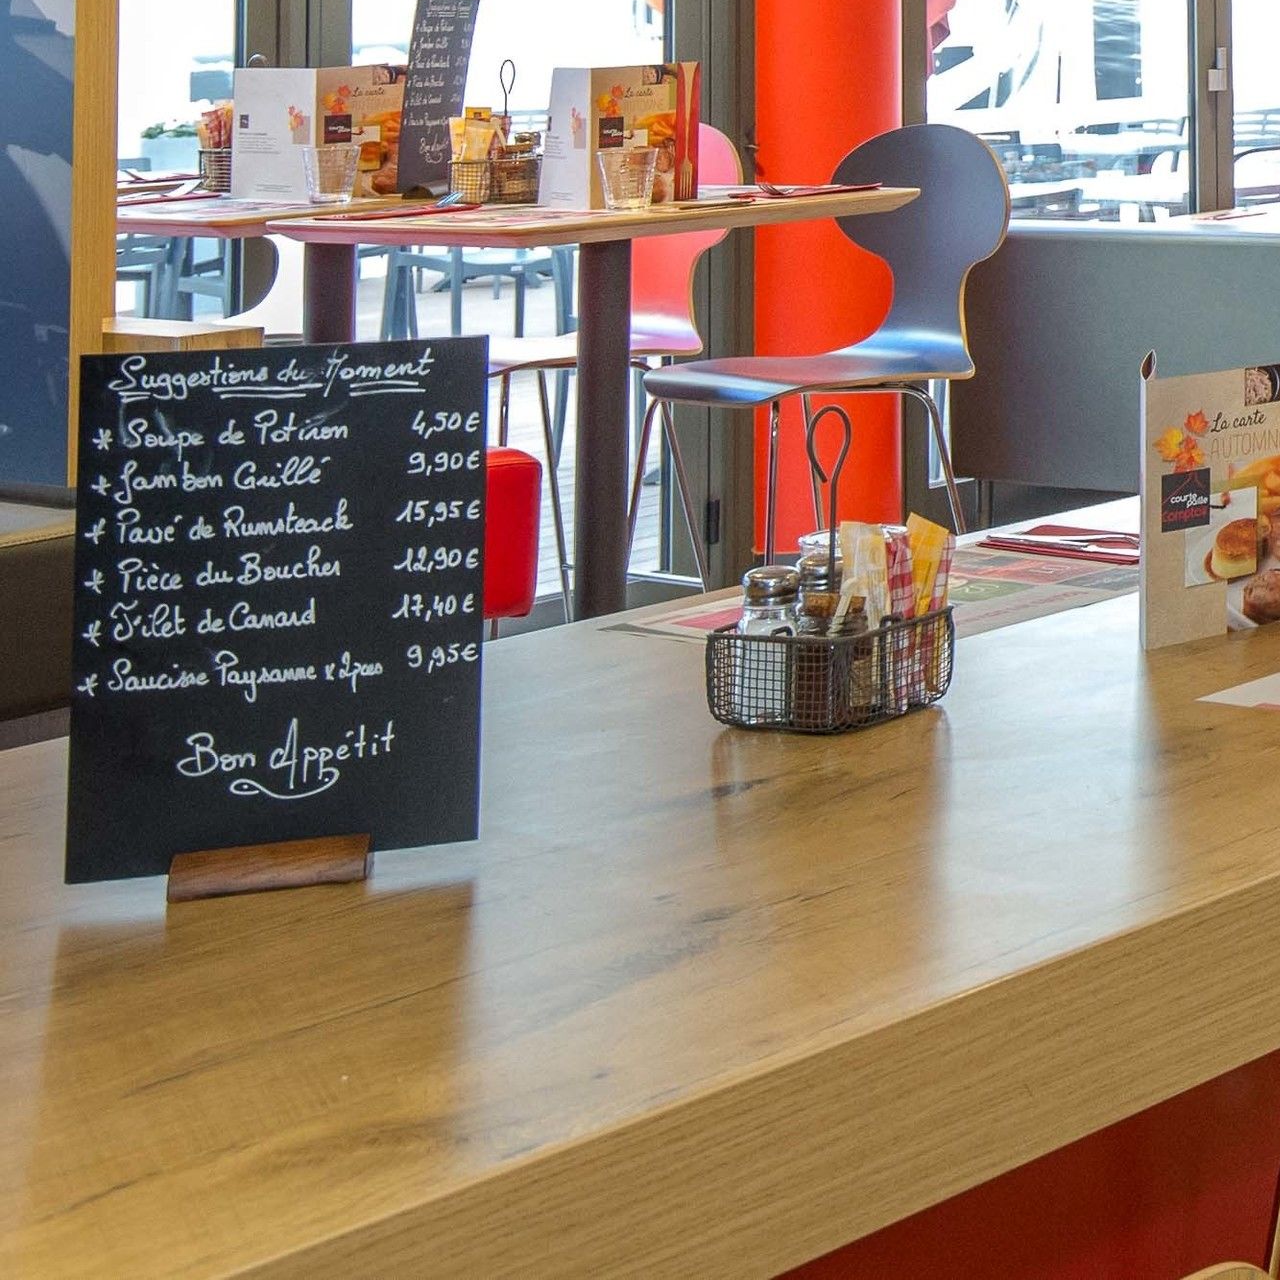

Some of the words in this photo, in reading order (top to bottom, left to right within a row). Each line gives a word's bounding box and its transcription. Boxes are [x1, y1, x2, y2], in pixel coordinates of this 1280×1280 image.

[108, 355, 269, 400] Suggestions
[276, 357, 308, 382] du
[125, 420, 205, 462] Soupe
[219, 419, 246, 446] de
[254, 409, 349, 443] Potiron
[410, 409, 481, 440] 4,50€
[1210, 411, 1231, 433] La
[1232, 409, 1267, 427] carte
[113, 462, 224, 504] Jambon
[233, 456, 332, 491] Grillé
[406, 452, 481, 477] 9,90€
[1170, 492, 1198, 504] courte
[115, 508, 183, 544] Pavé
[189, 517, 215, 541] de
[223, 498, 354, 539] Rumsteack
[395, 499, 482, 527] 15,95€
[117, 558, 184, 594] Pièce
[195, 560, 234, 587] du
[239, 546, 341, 581] Boucher
[393, 547, 479, 575] 12,90€
[110, 600, 186, 642] Filet
[197, 607, 226, 634] de
[228, 598, 317, 631] Canard
[392, 593, 475, 622] 17,40€
[107, 657, 210, 693] Saucisse
[214, 650, 318, 703] Paysanne
[406, 642, 480, 674] 9,95€
[176, 732, 257, 777] Bon
[269, 717, 395, 790] Appétit
